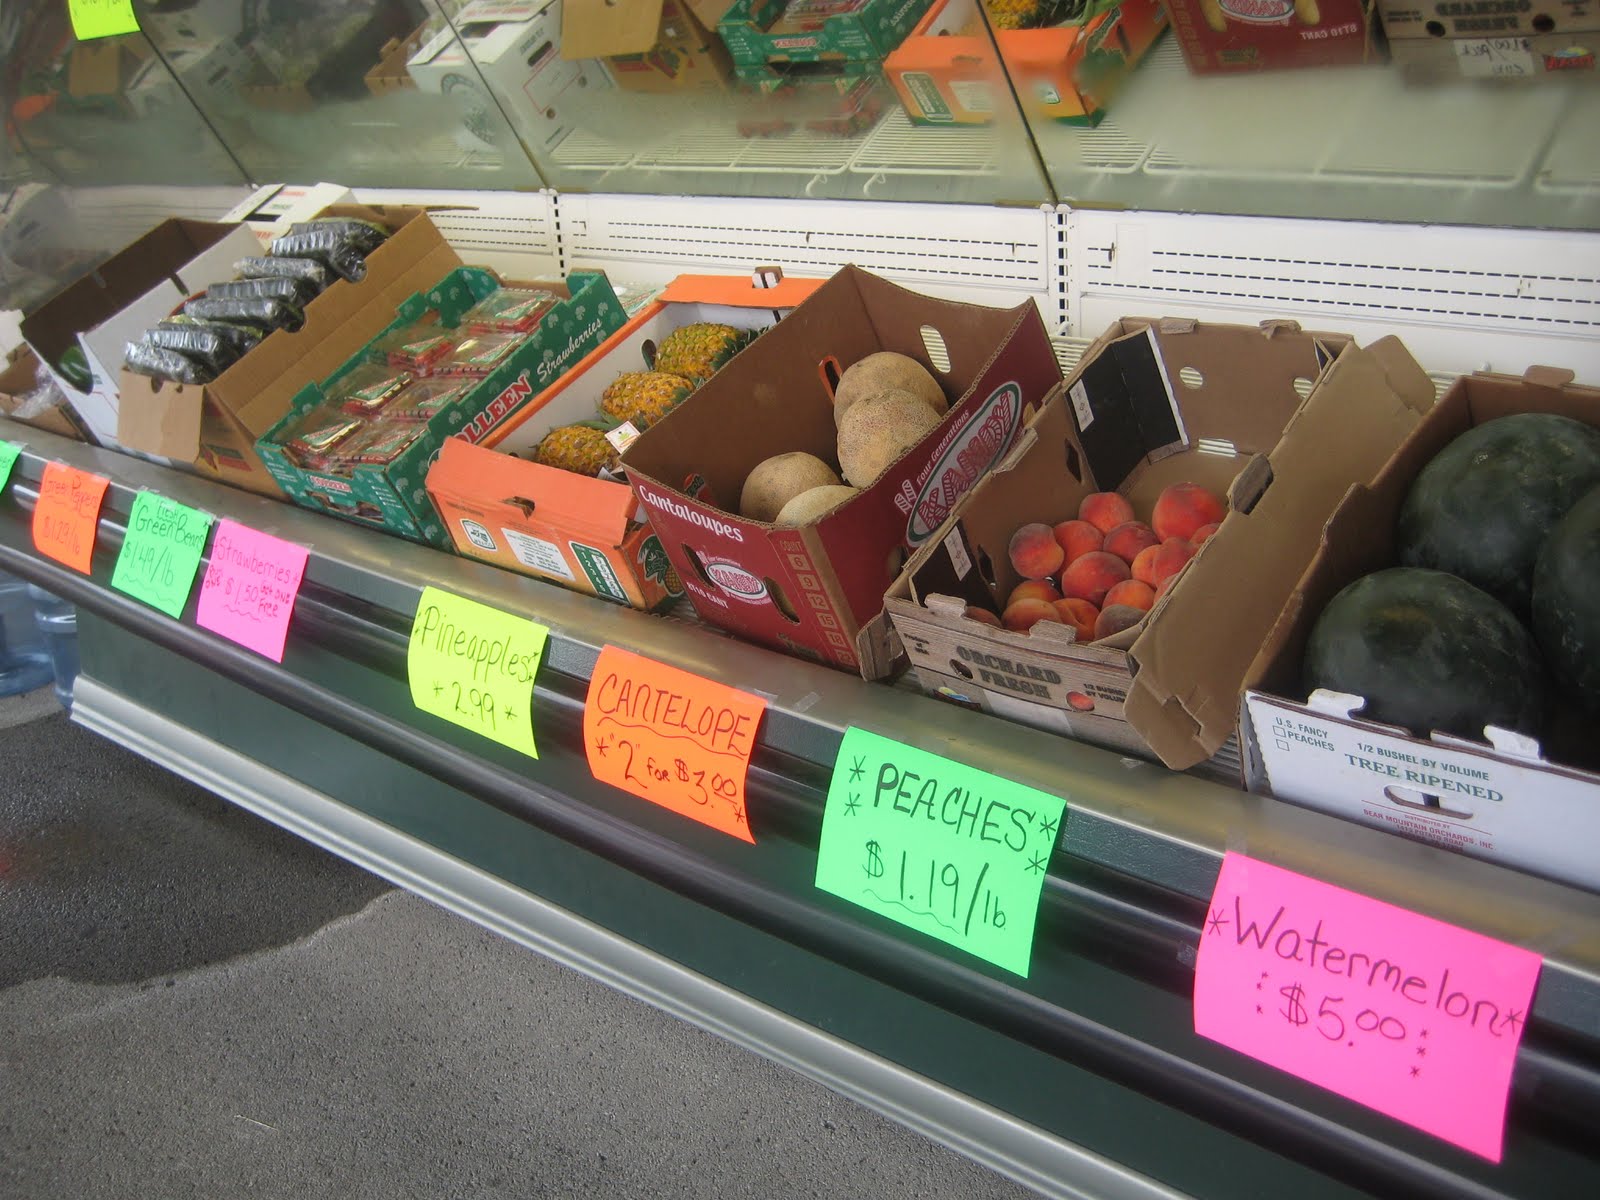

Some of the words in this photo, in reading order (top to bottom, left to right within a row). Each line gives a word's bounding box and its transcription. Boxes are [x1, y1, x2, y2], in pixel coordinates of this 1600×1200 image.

[536, 317, 602, 383] Strawberries
[916, 464, 933, 487] Four
[931, 409, 970, 462] Generations
[136, 505, 177, 537] Green
[175, 513, 205, 552] Beans
[639, 484, 744, 543] Cantaloupes
[217, 536, 291, 584] Strawberries
[812, 595, 826, 608] 12
[821, 615, 834, 626] 15
[422, 605, 531, 683] Pineapples
[956, 645, 1062, 685] ORCHARD
[452, 681, 496, 731] 2.99
[978, 668, 1052, 700] FRESH
[597, 673, 751, 757] CANTELOPE
[1275, 717, 1296, 730] U.S.
[1298, 723, 1329, 739] FANCY
[1287, 731, 1335, 752] PEACHES
[1357, 742, 1374, 754] 1/2
[1377, 747, 1418, 764] BUSHEL
[1423, 758, 1437, 769] BY
[1440, 762, 1490, 781] VOLUME
[1344, 752, 1400, 778] TREE
[1405, 769, 1504, 802] RIPENED
[874, 763, 1036, 852] PEACHES
[1363, 808, 1384, 819] BEAR
[1385, 815, 1428, 831] MOUNTAIN
[862, 840, 1006, 936] $1.19/lb
[1235, 896, 1502, 1037] Watermelon
[1279, 982, 1406, 1047] $5.00
